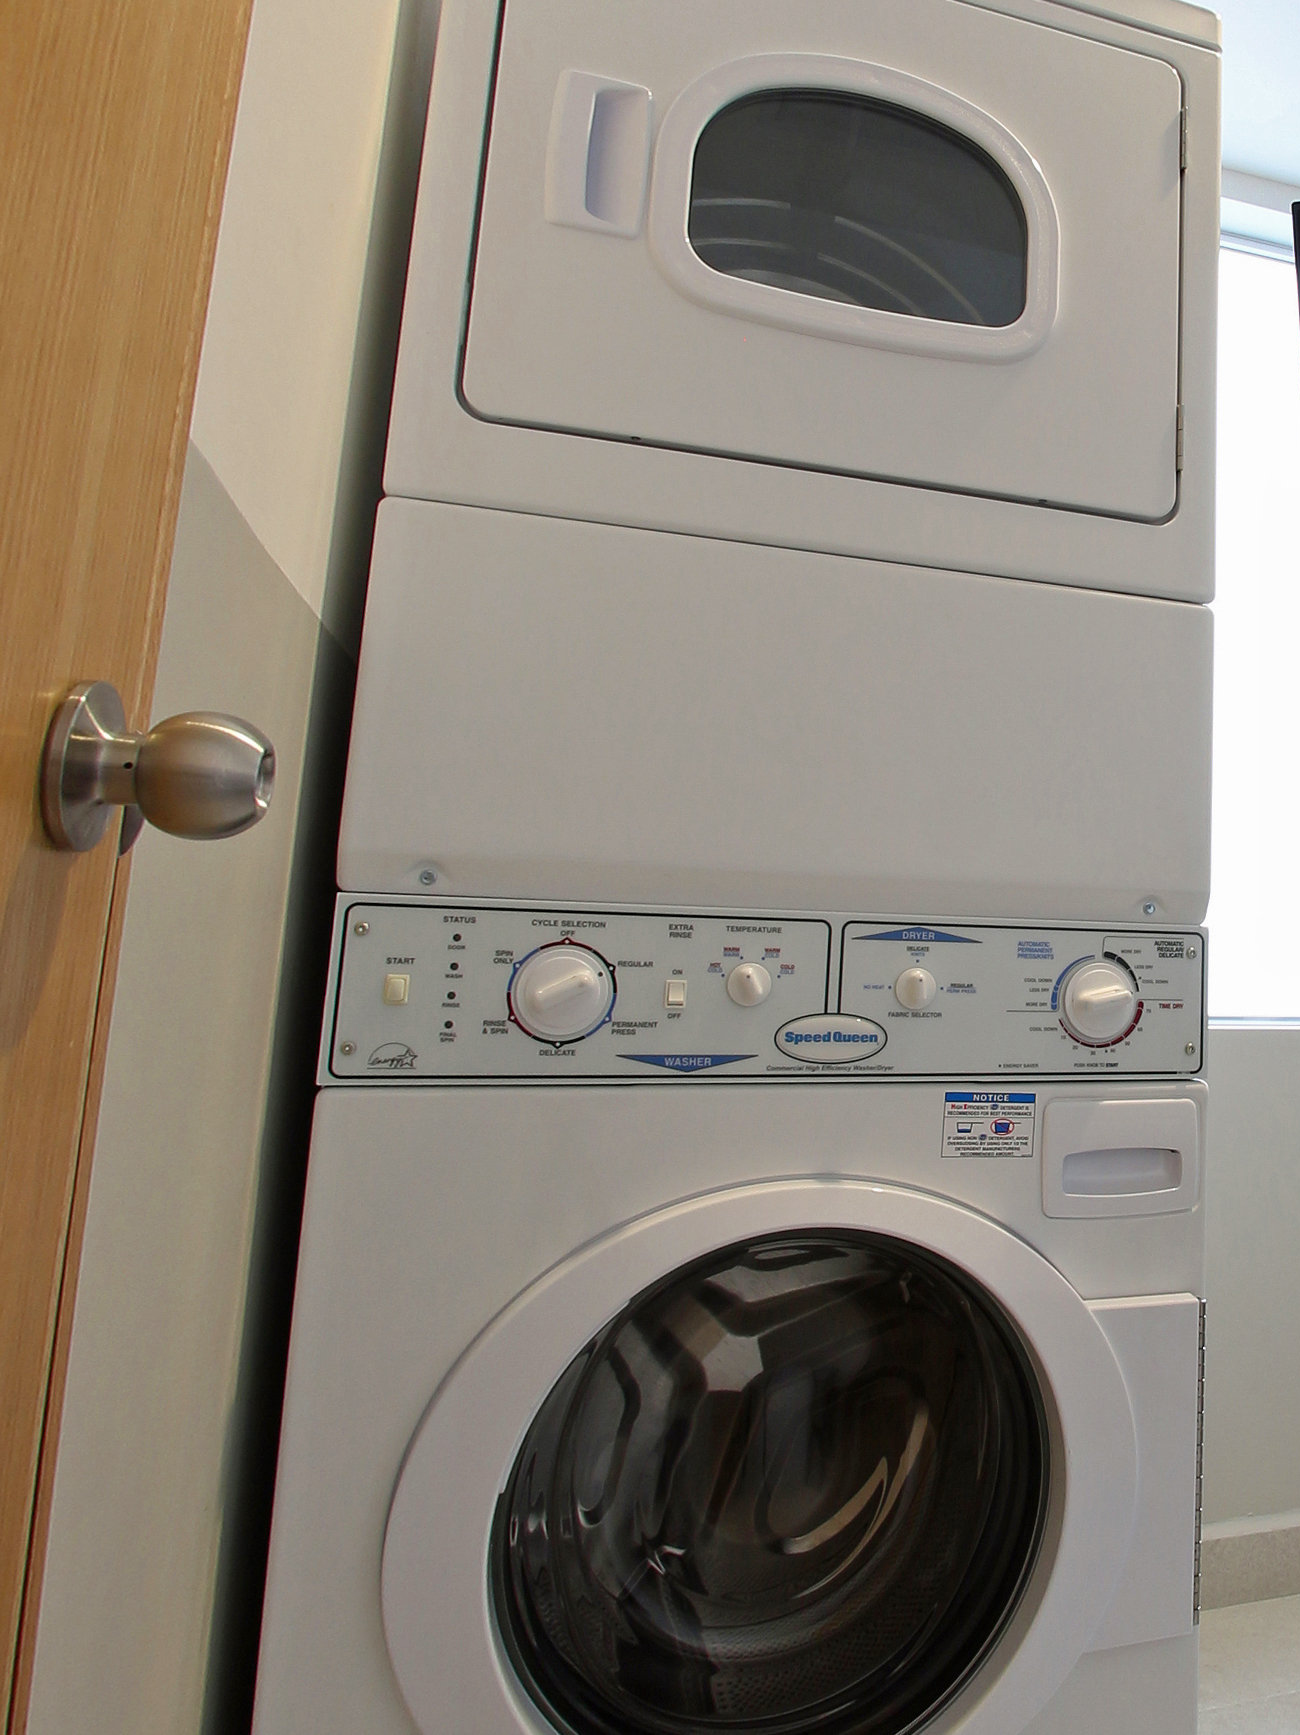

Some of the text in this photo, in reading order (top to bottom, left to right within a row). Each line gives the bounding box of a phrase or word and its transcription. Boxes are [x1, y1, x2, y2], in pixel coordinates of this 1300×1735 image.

[443, 916, 476, 924] STATUS
[531, 919, 607, 929] CYCLE SELECTION
[668, 924, 694, 932] EXTRA
[726, 925, 782, 934] TEMPERATURE
[902, 931, 936, 940] DRYER
[386, 957, 416, 965] START
[493, 957, 514, 965] ONLY
[611, 1021, 658, 1029] PERMANENT
[785, 1031, 878, 1045] Speed Queen
[664, 1057, 712, 1067] WASHER
[805, 1065, 821, 1073] High
[822, 1065, 852, 1073] Efficiency
[973, 1094, 1010, 1102] NOTICE
